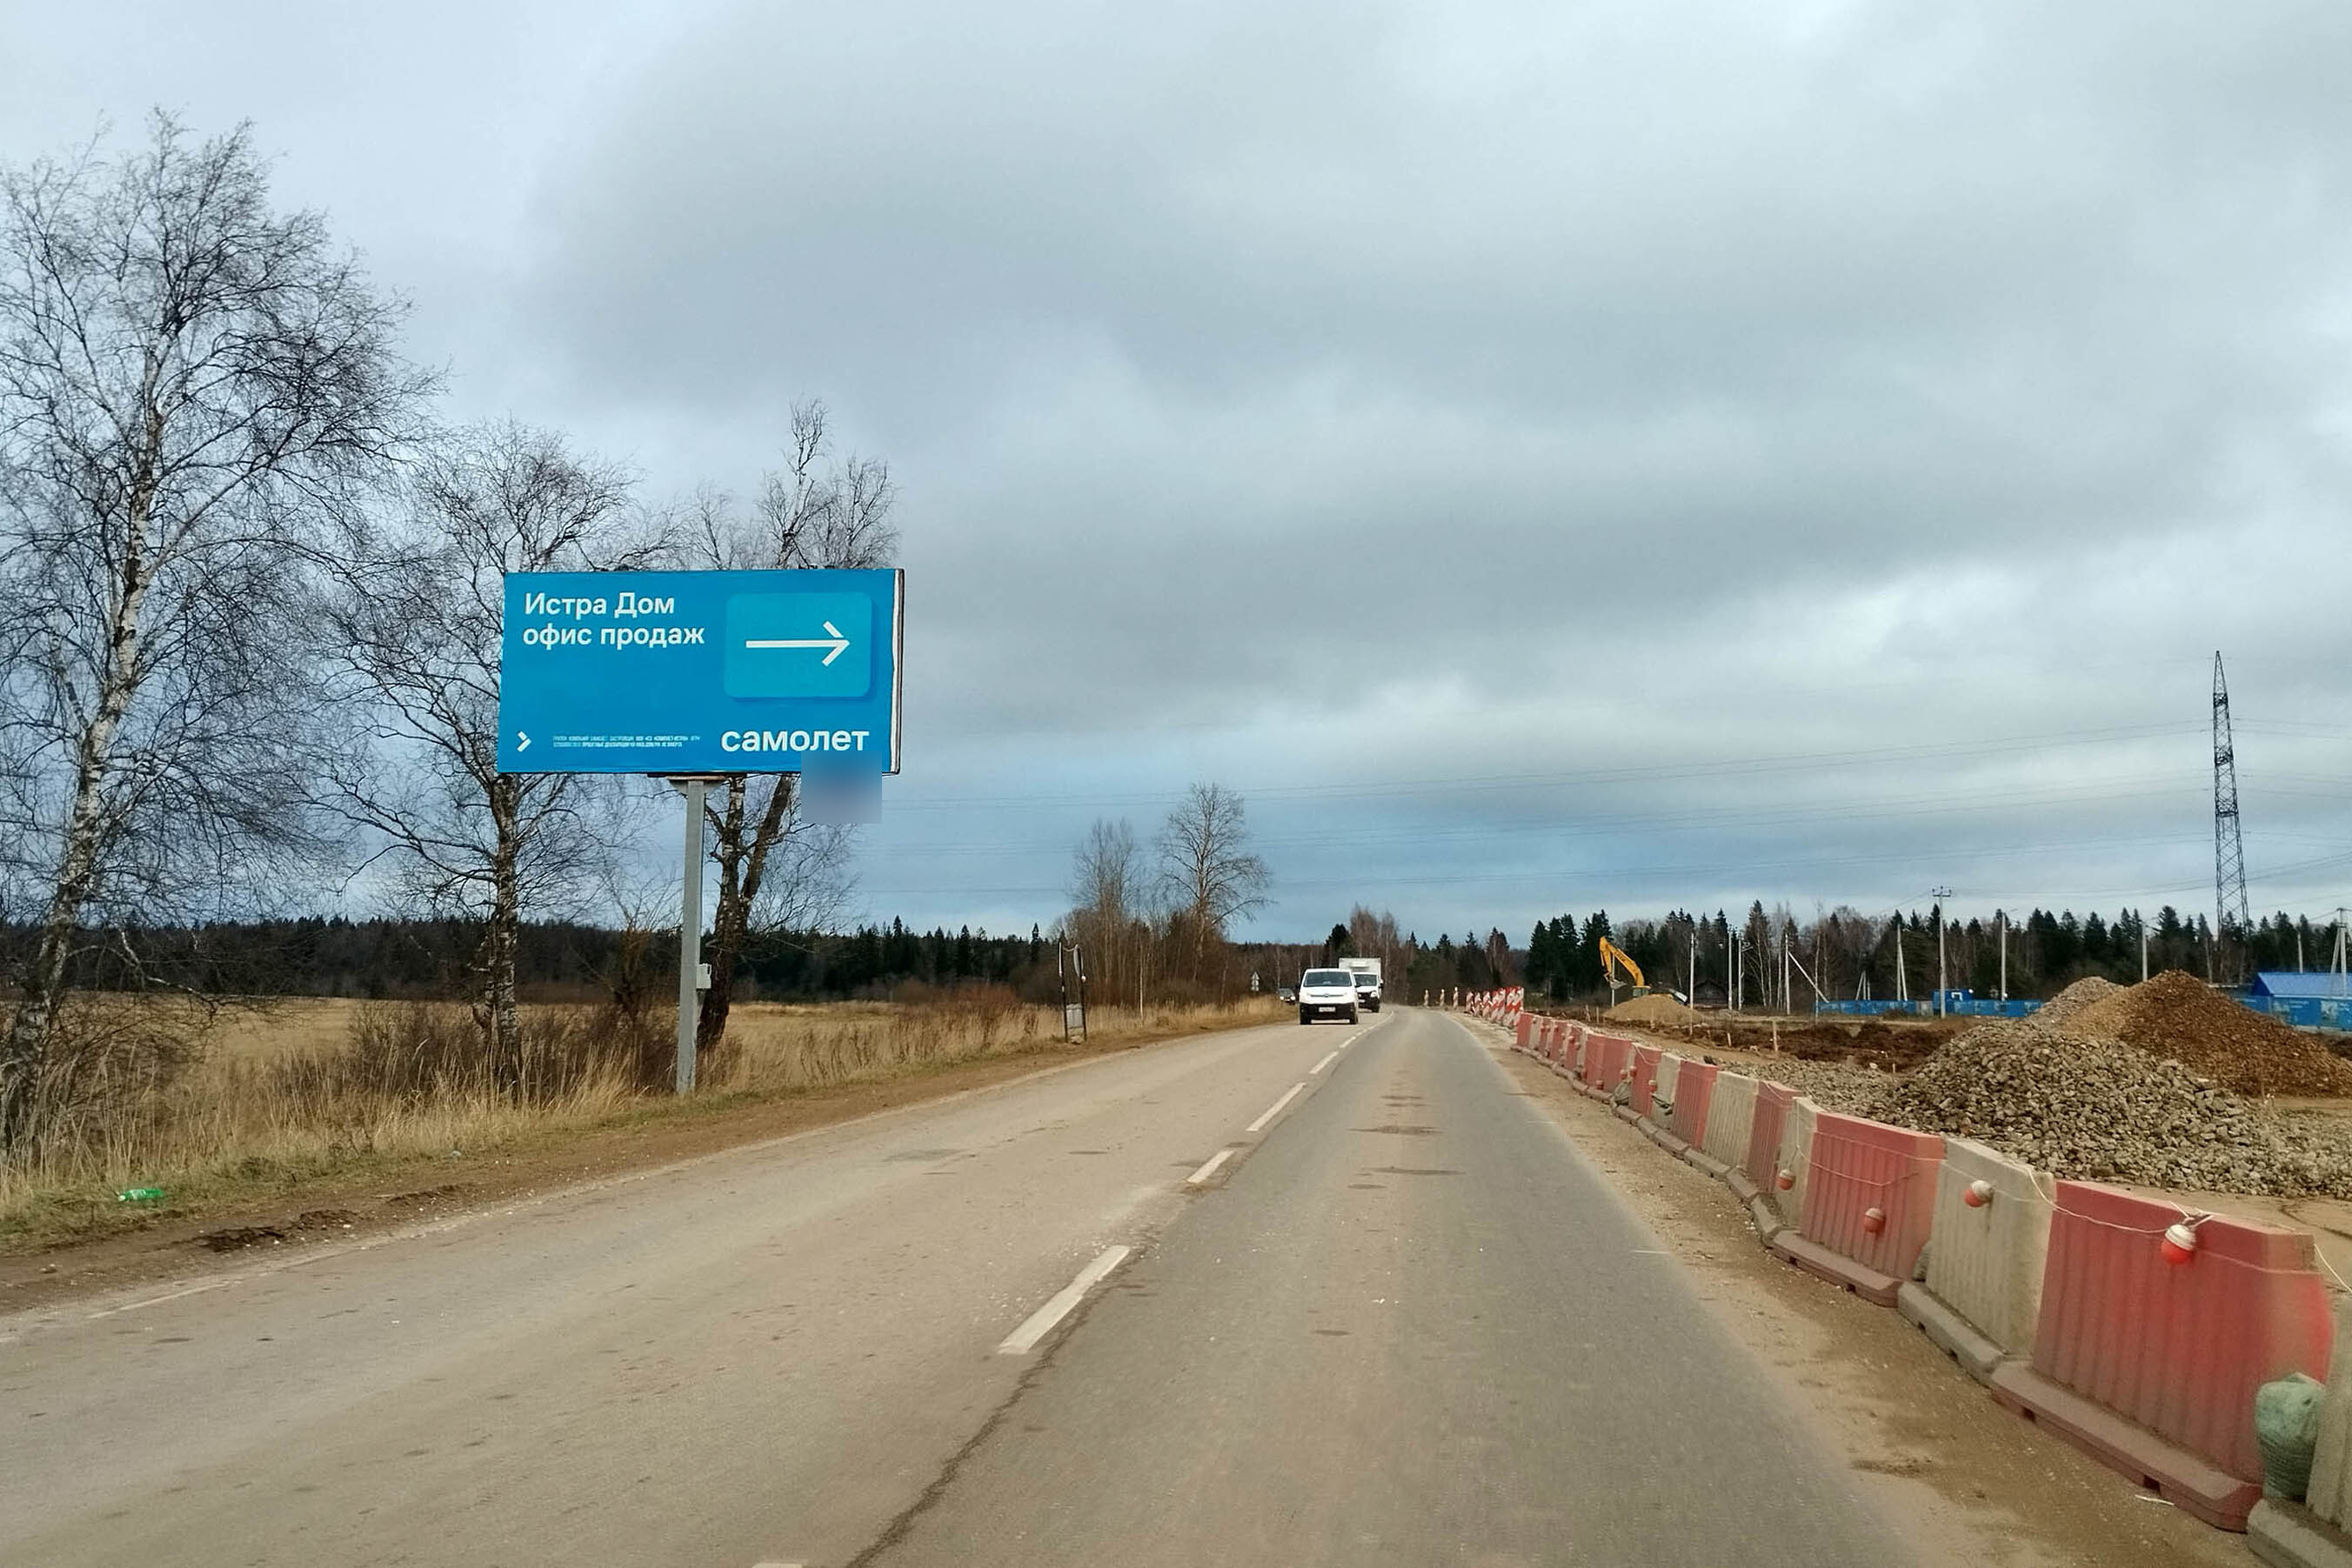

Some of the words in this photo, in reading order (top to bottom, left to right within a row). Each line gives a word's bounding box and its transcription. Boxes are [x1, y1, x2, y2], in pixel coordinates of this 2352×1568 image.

[525, 592, 606, 620] Истра
[614, 591, 674, 618] Дом
[523, 623, 592, 651] офис
[599, 627, 705, 651] продаж
[721, 730, 870, 752] самолет
